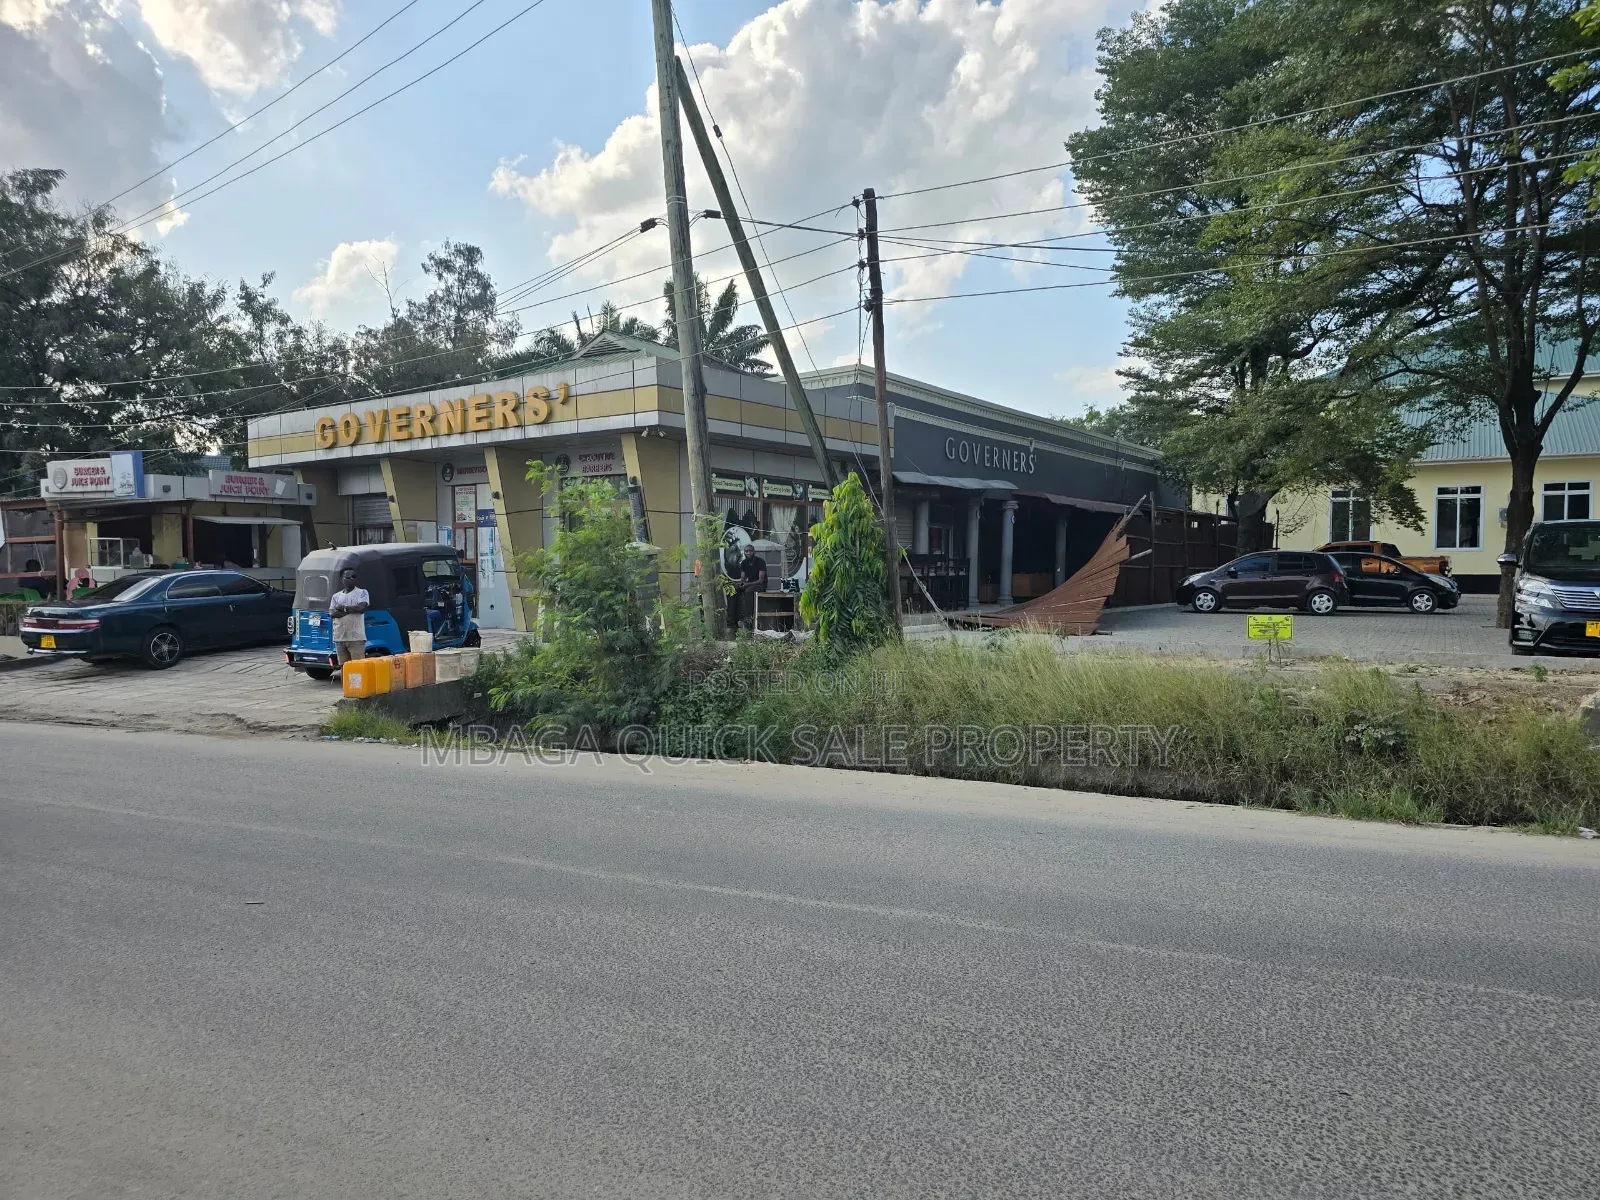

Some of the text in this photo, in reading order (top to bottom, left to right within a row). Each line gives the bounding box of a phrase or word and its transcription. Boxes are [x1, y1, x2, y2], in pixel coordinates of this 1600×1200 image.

[224, 475, 257, 484] BURGER
[220, 484, 268, 495] JUICE POINT
